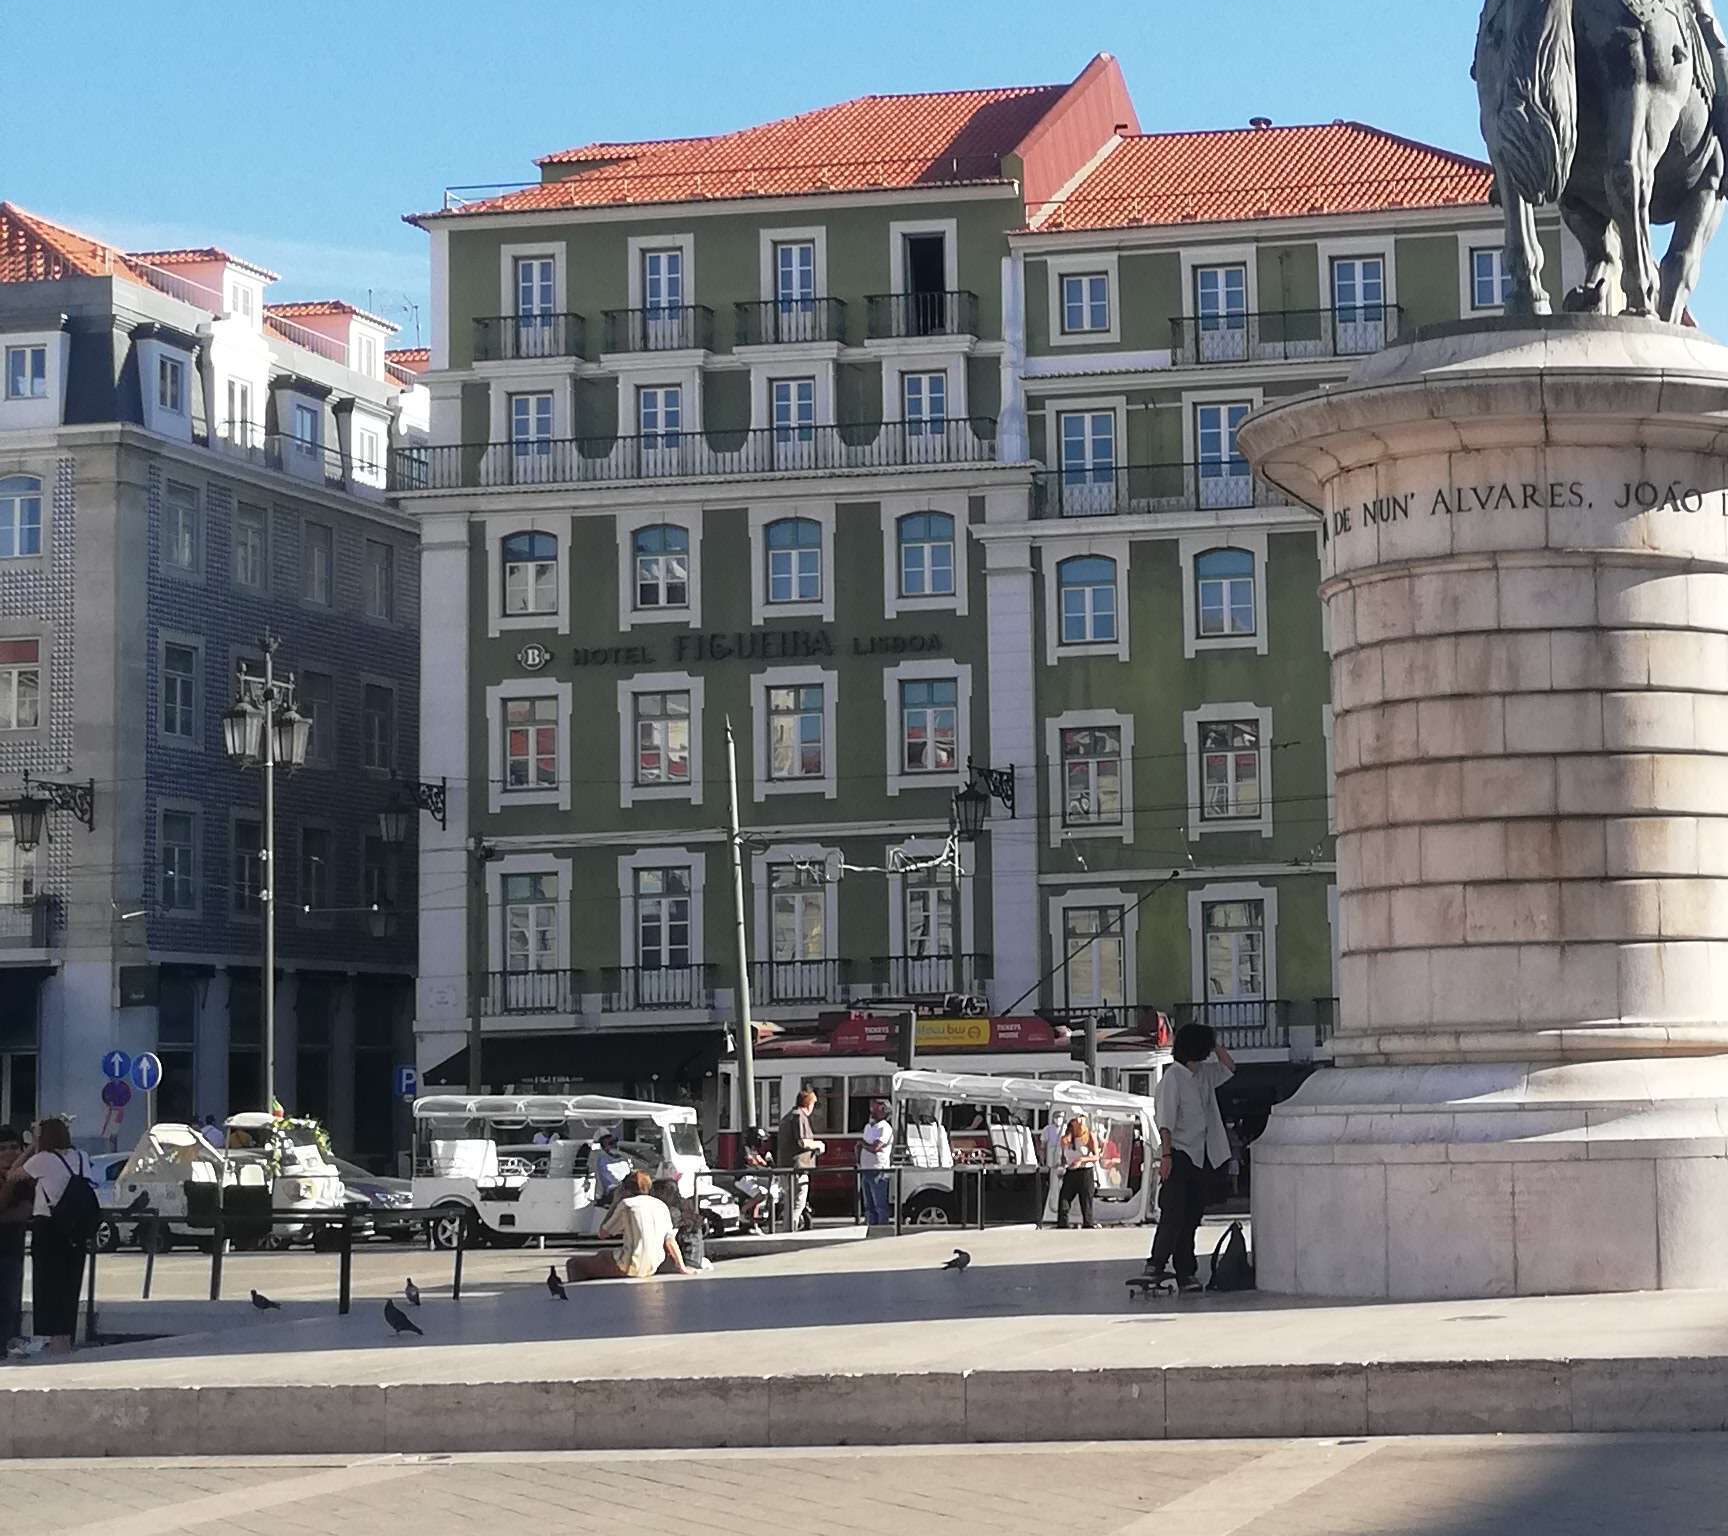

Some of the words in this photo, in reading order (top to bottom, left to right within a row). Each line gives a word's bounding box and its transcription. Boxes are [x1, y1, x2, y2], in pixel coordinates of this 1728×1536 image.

[1334, 507, 1352, 536] DE
[1614, 481, 1703, 513] JOÃO
[526, 648, 541, 665] B
[573, 645, 657, 667] HOTEL
[672, 629, 835, 662] FIGUEIRA
[852, 633, 944, 655] LISBOA
[402, 1068, 416, 1093] P
